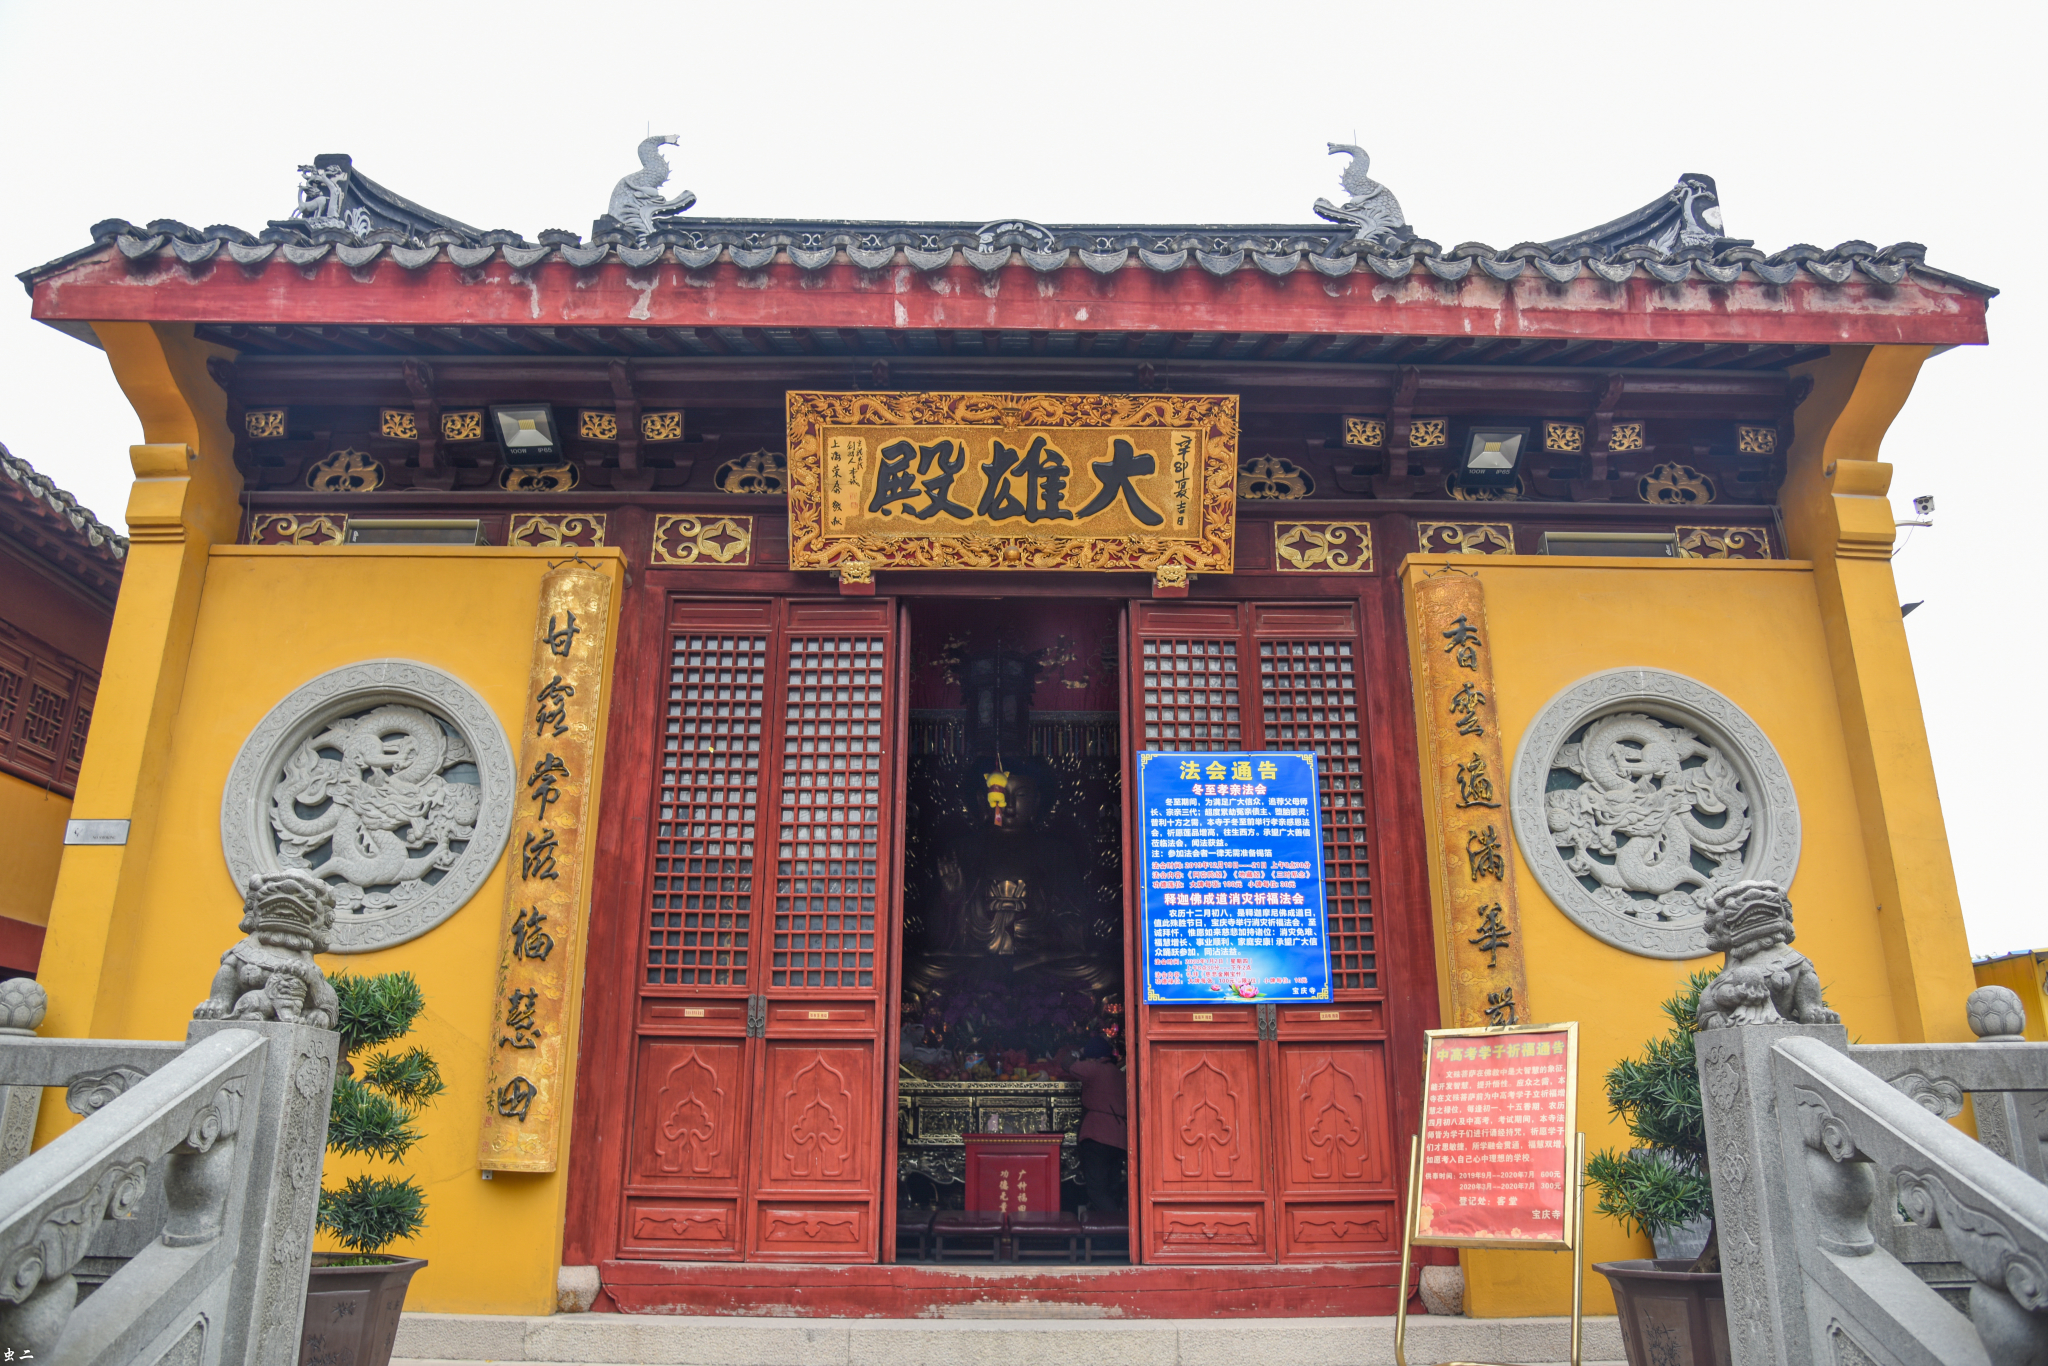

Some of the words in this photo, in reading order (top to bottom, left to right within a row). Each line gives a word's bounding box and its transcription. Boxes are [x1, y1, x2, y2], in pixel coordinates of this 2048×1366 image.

[868, 435, 1165, 527] 大雄殿
[1173, 434, 1193, 526] 辛卯夏吉日
[1179, 760, 1278, 781] 法会通告
[1191, 783, 1268, 796] 冬至孝亲法会
[1163, 892, 1305, 906] 释迦佛成道消灾祈福法会
[1291, 986, 1317, 995] 宝庆寺
[1436, 1041, 1566, 1062] 中高考学子祈福通告
[1540, 1170, 1561, 1179] 600元
[999, 1170, 1010, 1213] 功德无量
[1017, 1169, 1028, 1212] 广种福田
[1540, 1181, 1562, 1190] 300元
[1531, 1209, 1561, 1220] 宝庆寺
